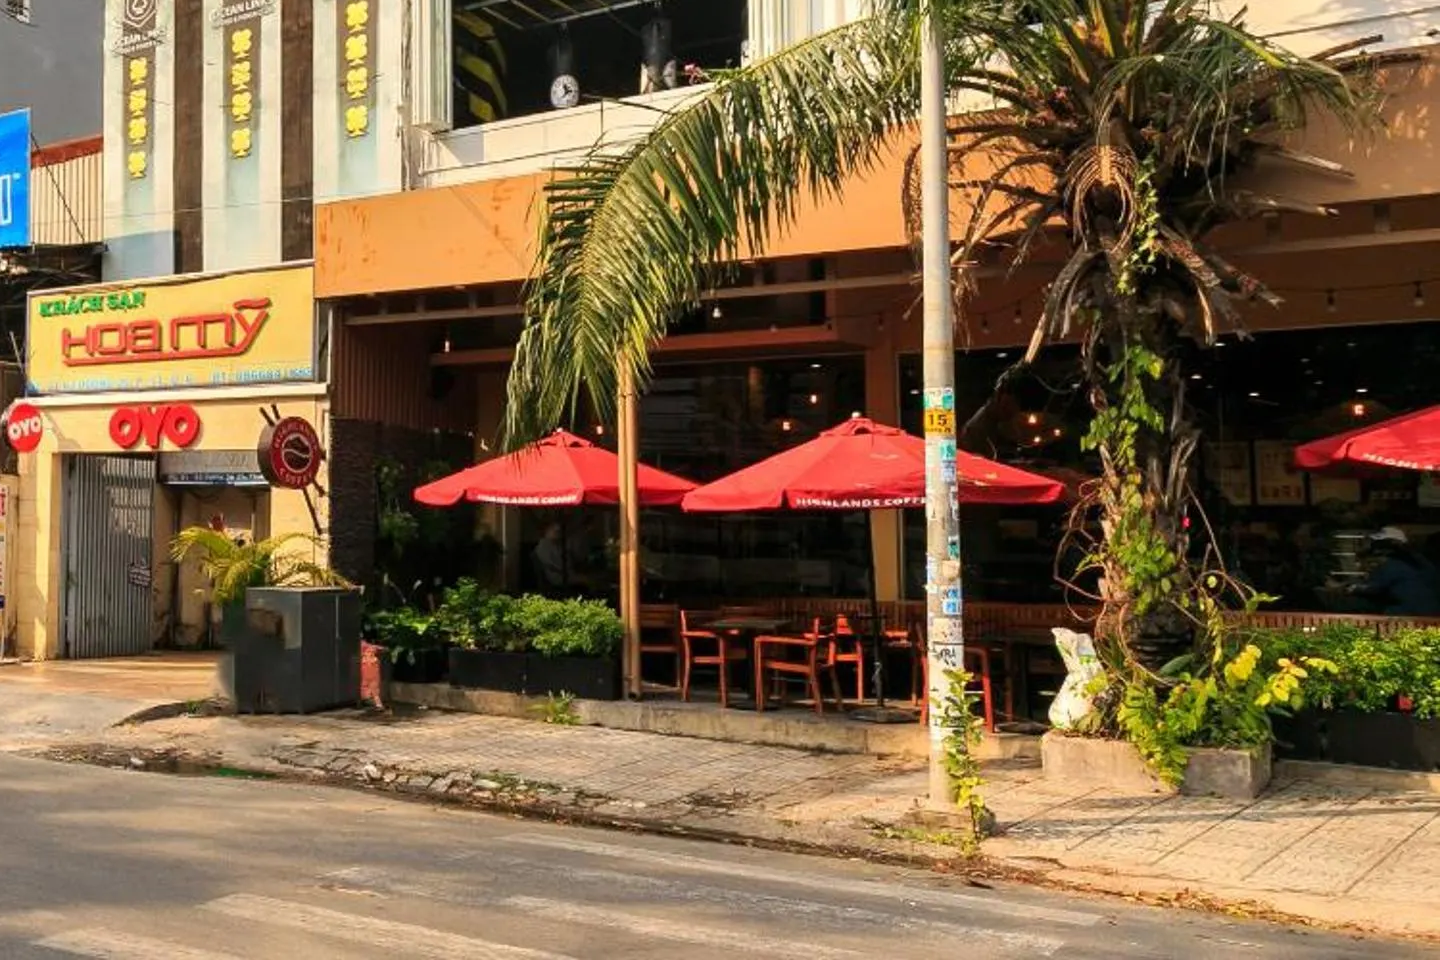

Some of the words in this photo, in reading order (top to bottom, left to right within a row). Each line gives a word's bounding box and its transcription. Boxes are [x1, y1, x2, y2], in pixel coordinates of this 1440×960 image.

[39, 295, 104, 317] KHÁCH
[8, 415, 41, 441] OYO
[110, 404, 201, 450] OYO
[928, 414, 947, 427] 15
[883, 496, 928, 507] COFFE
